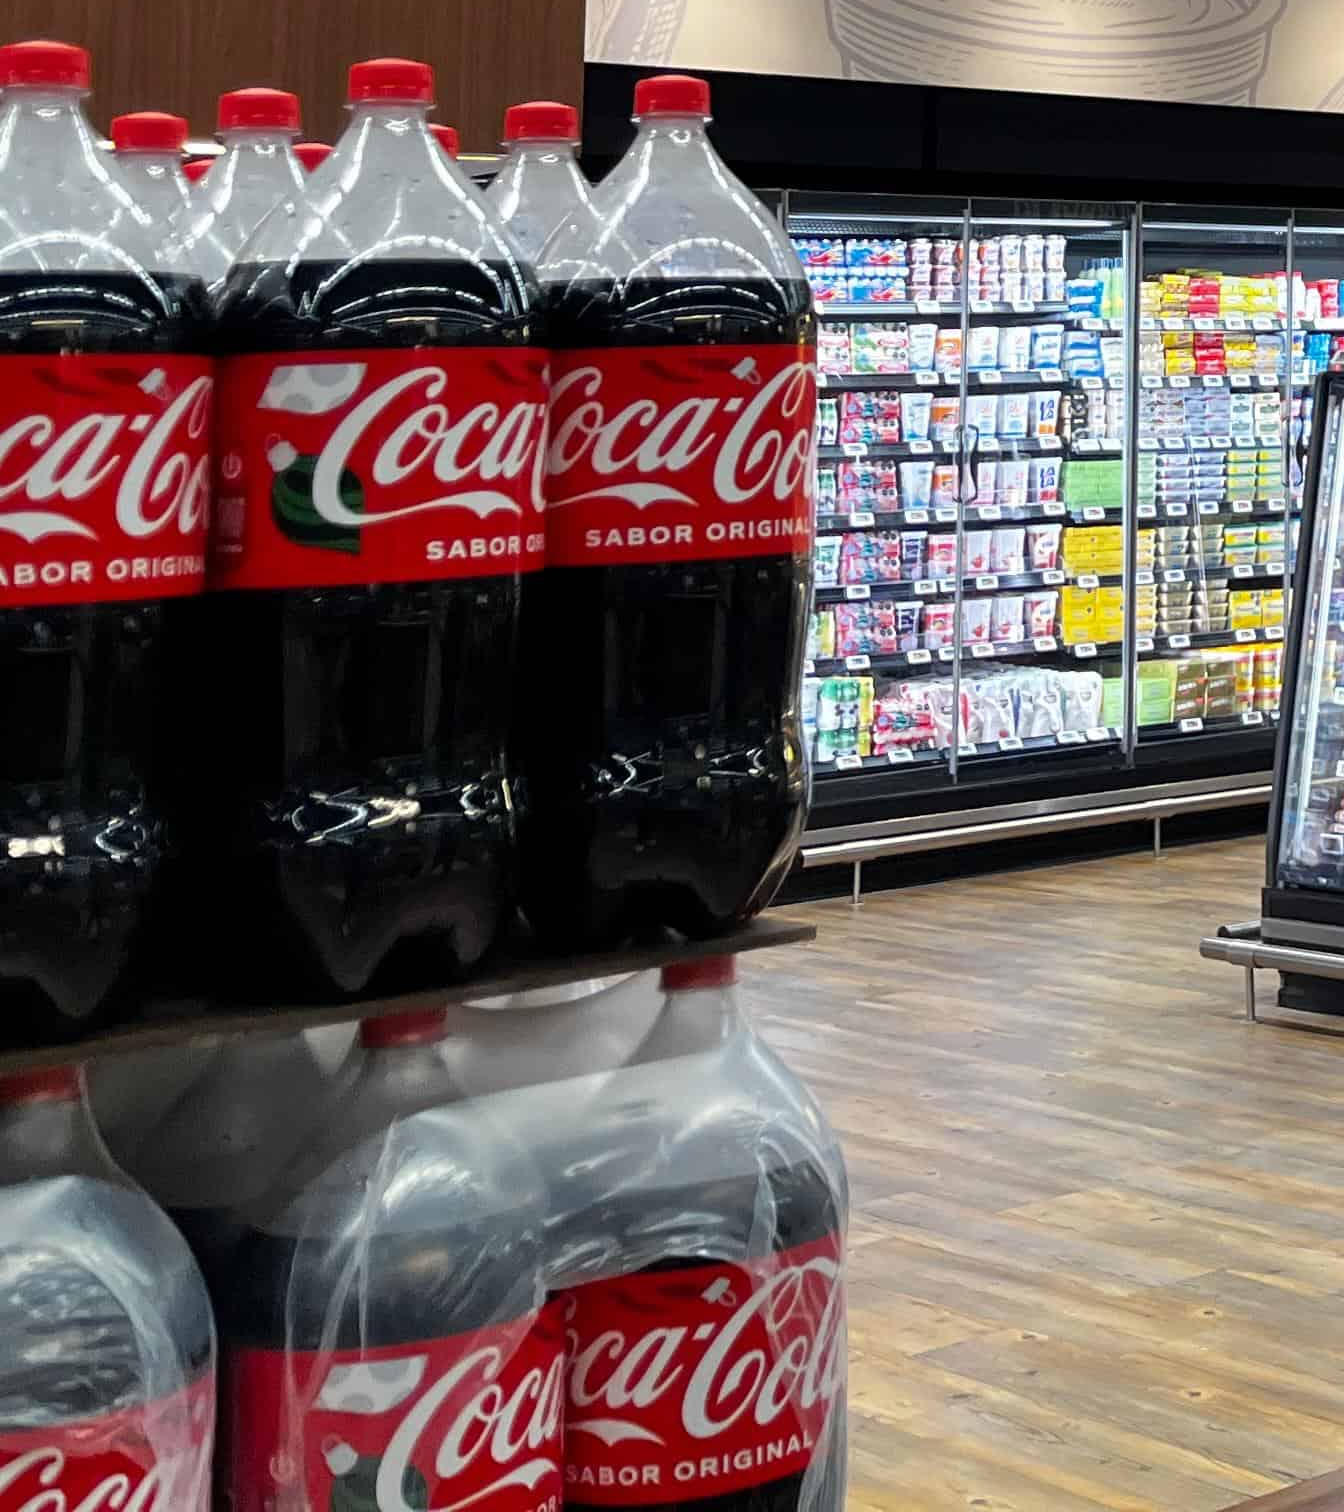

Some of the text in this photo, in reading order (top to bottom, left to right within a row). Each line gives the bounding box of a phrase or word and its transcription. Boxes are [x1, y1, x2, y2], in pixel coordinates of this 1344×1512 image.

[426, 535, 521, 560] SABOR
[585, 517, 812, 549] SABOR ORIGINAL
[565, 1429, 814, 1486] SABOR ORIGINAL
